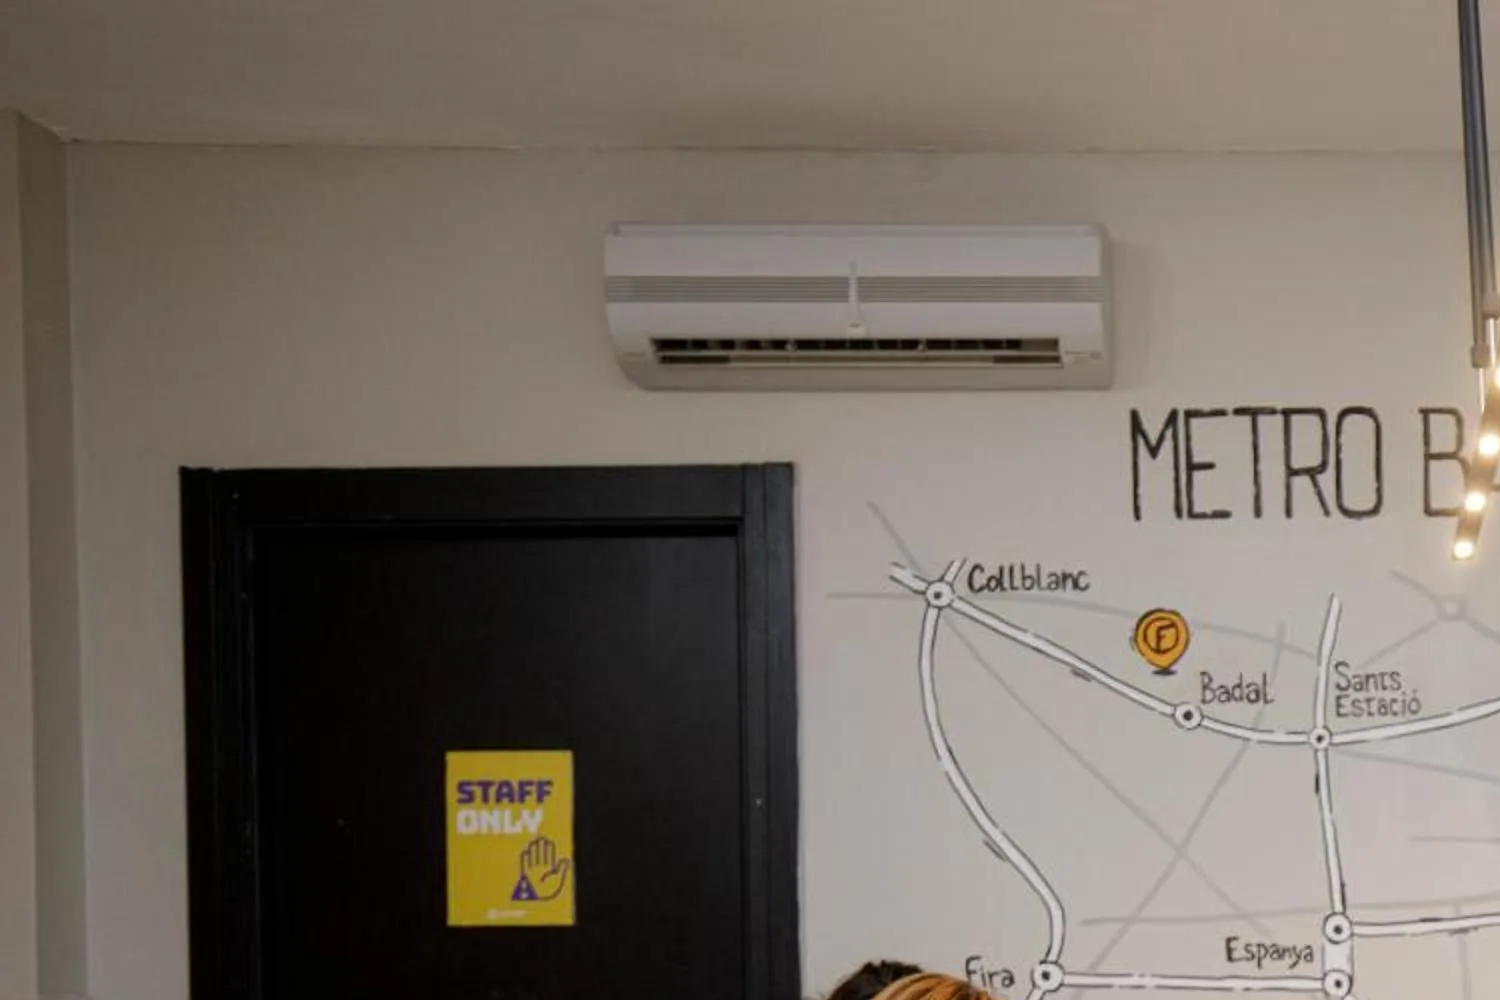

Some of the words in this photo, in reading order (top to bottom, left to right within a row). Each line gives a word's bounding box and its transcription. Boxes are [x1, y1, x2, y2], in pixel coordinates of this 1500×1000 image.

[1129, 405, 1383, 520] METRO
[967, 562, 1091, 594] Collblanc
[1200, 671, 1276, 705] Badal
[1334, 660, 1402, 692] Sants
[1335, 688, 1422, 718] Estació
[456, 779, 554, 805] STAFF
[456, 807, 544, 836] ONLY
[1225, 935, 1314, 970] Espanya
[965, 954, 1015, 990] Fira
